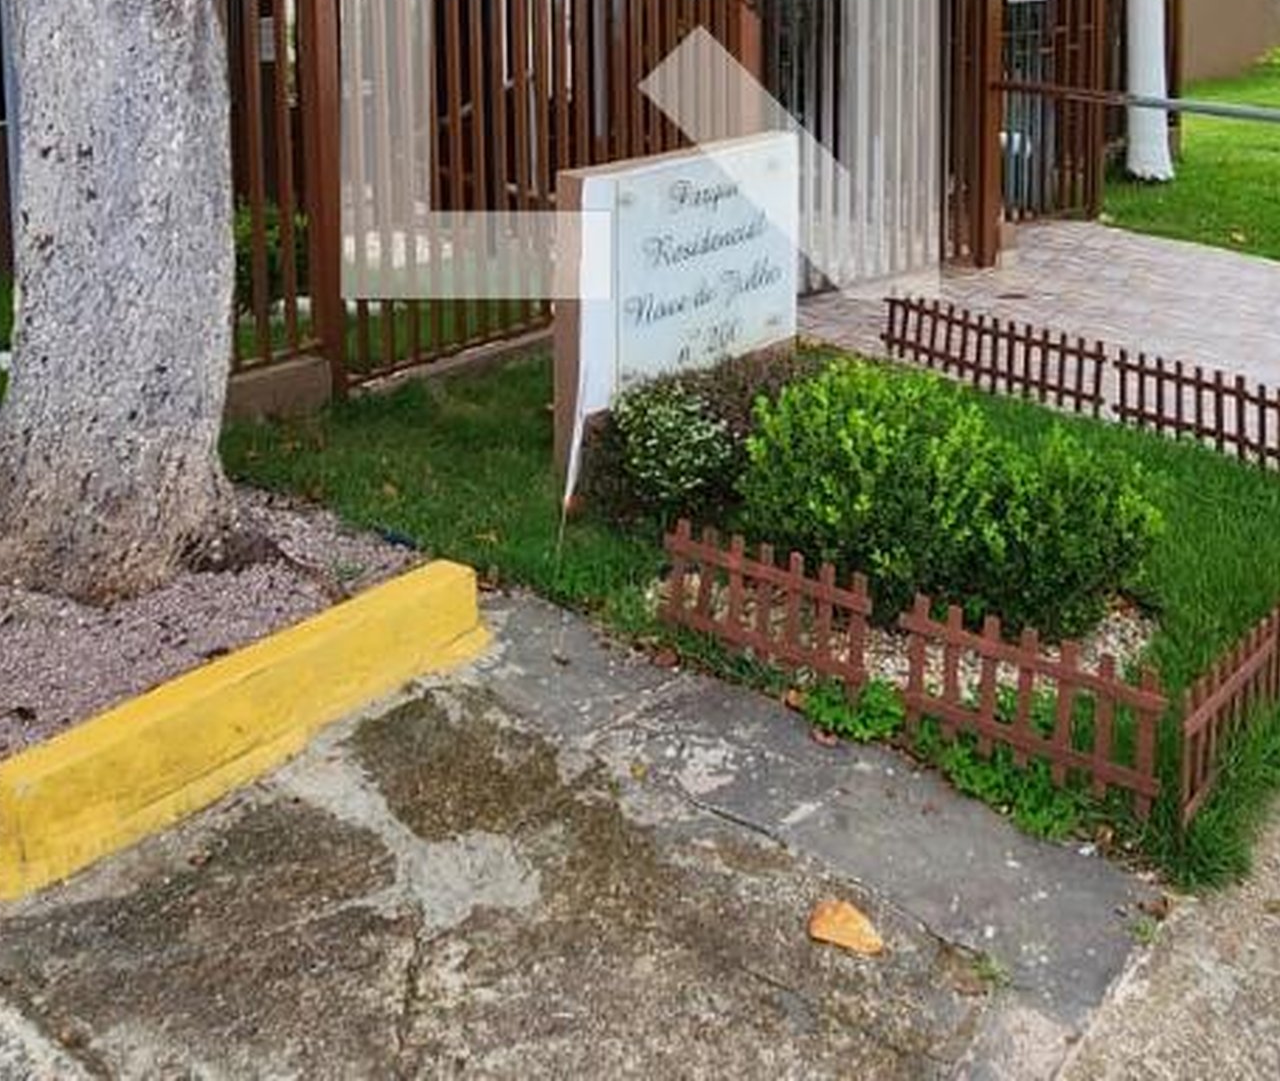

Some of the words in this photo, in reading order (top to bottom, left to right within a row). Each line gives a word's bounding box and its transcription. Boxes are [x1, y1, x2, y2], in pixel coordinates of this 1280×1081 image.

[642, 209, 768, 267] Residencial
[624, 293, 687, 325] Nove
[720, 255, 782, 306] Julho
